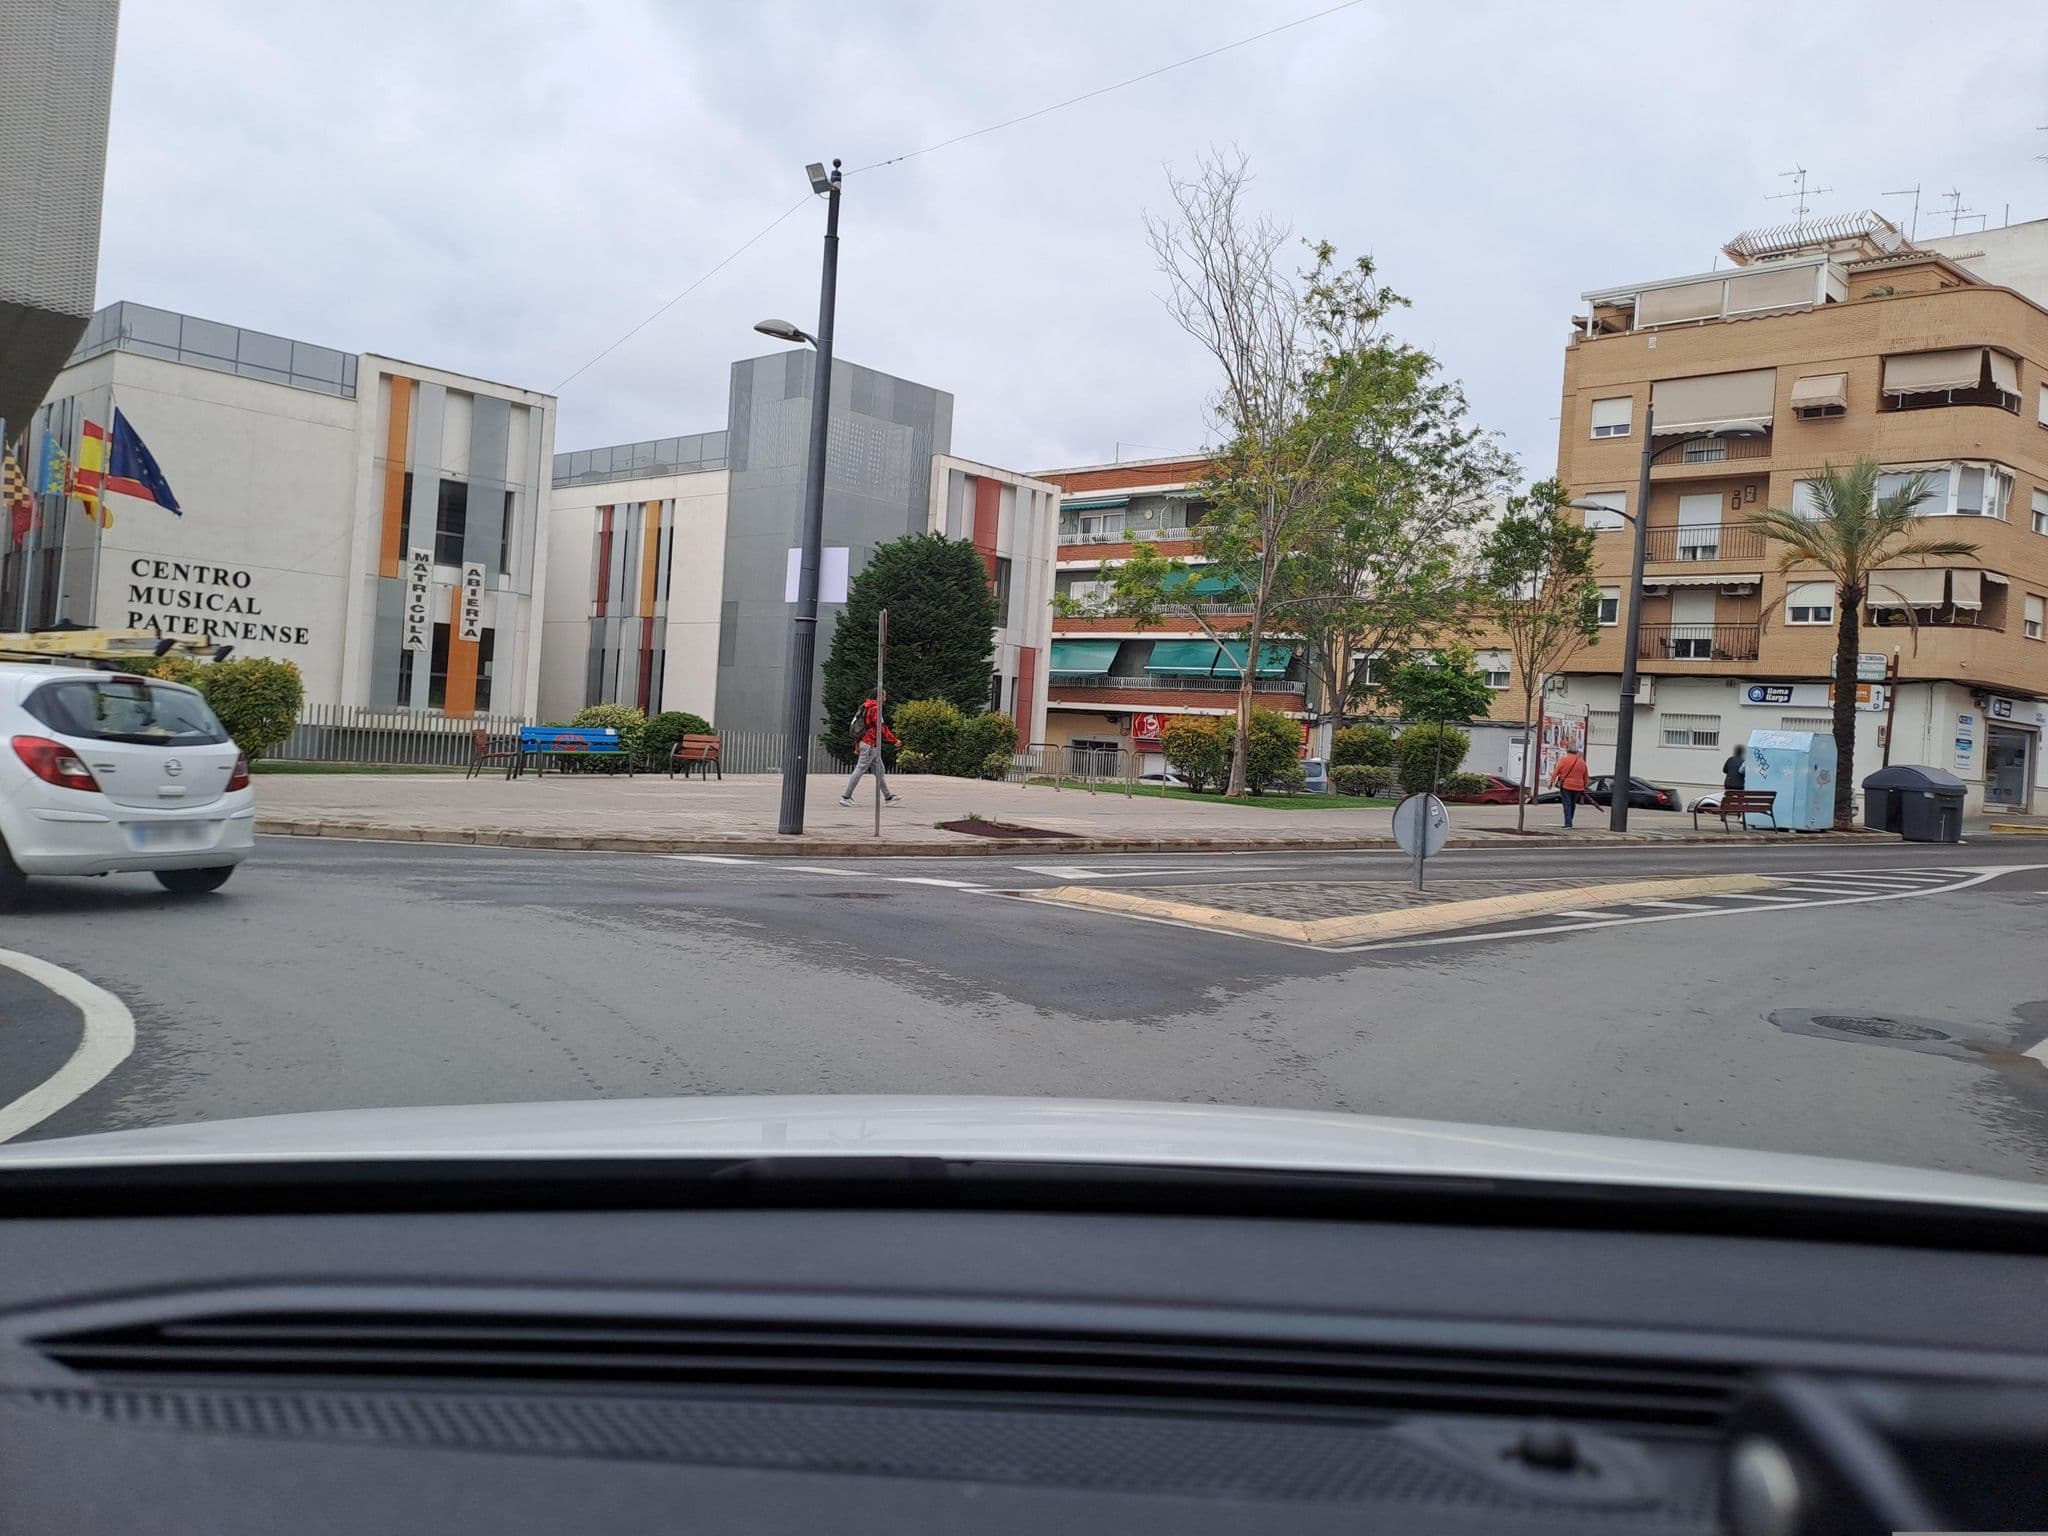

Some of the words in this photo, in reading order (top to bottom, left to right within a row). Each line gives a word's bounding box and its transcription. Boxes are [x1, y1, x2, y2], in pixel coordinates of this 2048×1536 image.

[131, 558, 251, 589] CENTRO
[129, 584, 262, 615] MUSICAL
[408, 552, 429, 645] MATRICULA
[464, 568, 481, 637] ABIERTA
[127, 611, 309, 645] PATERNENSE
